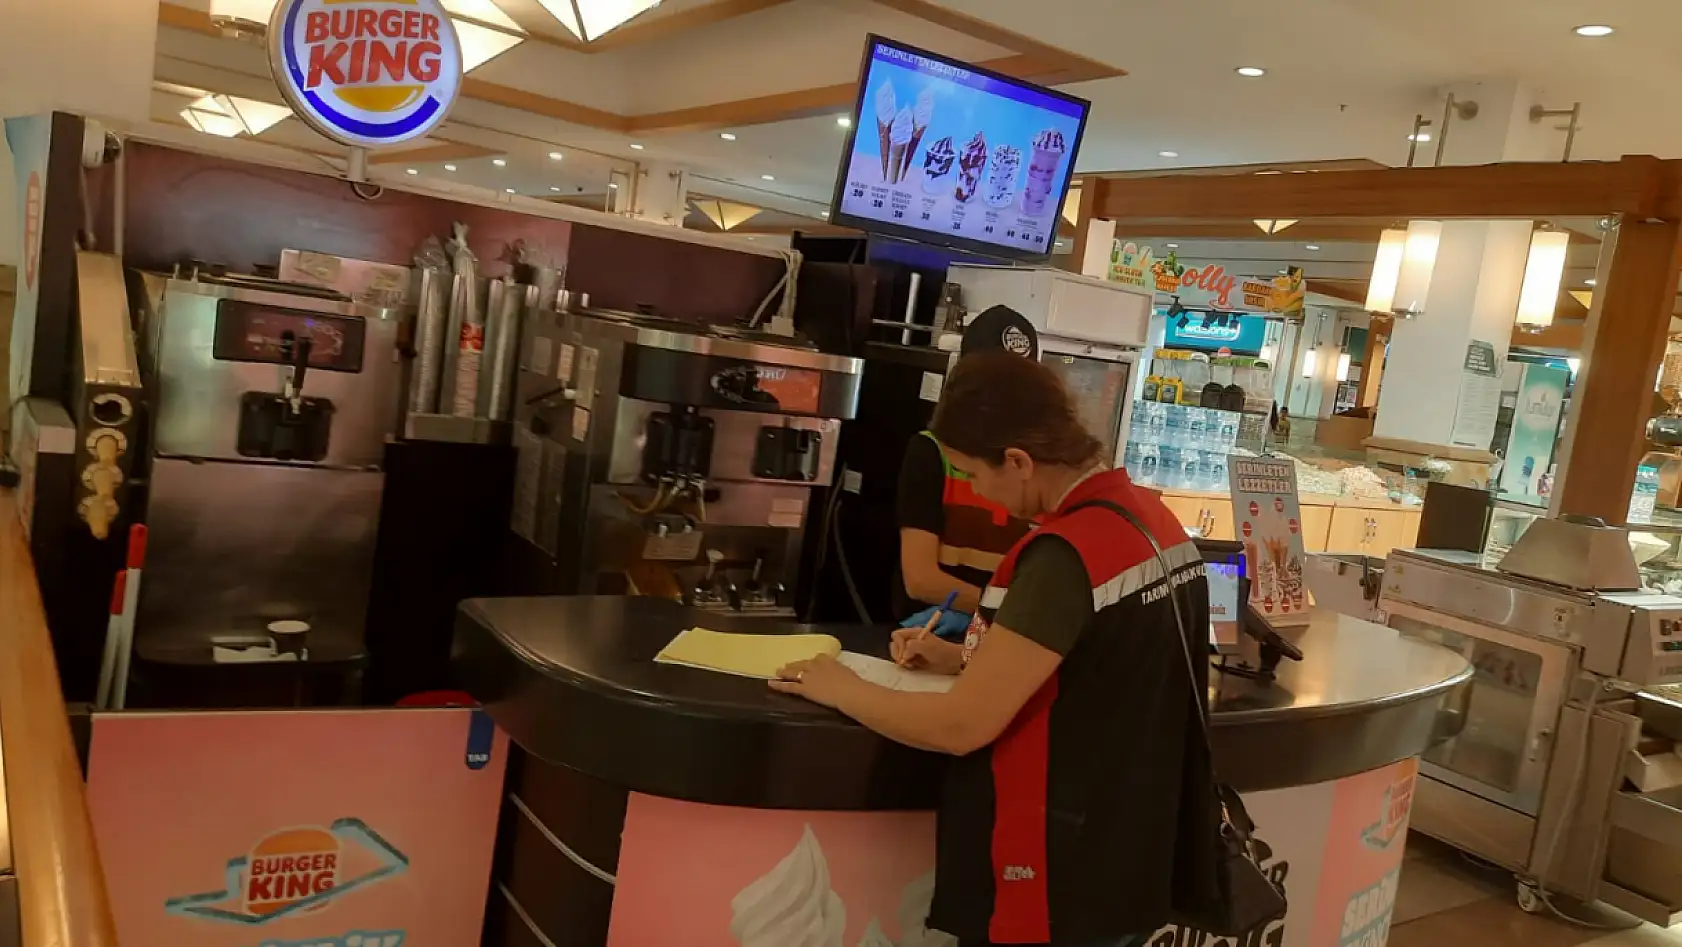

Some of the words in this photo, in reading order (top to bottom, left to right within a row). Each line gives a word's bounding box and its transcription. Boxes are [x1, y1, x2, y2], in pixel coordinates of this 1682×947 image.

[305, 9, 440, 43] BURGER
[307, 39, 442, 88] KING
[1007, 338, 1030, 350] KING
[251, 853, 337, 877] BURGER
[248, 871, 334, 902] KING
